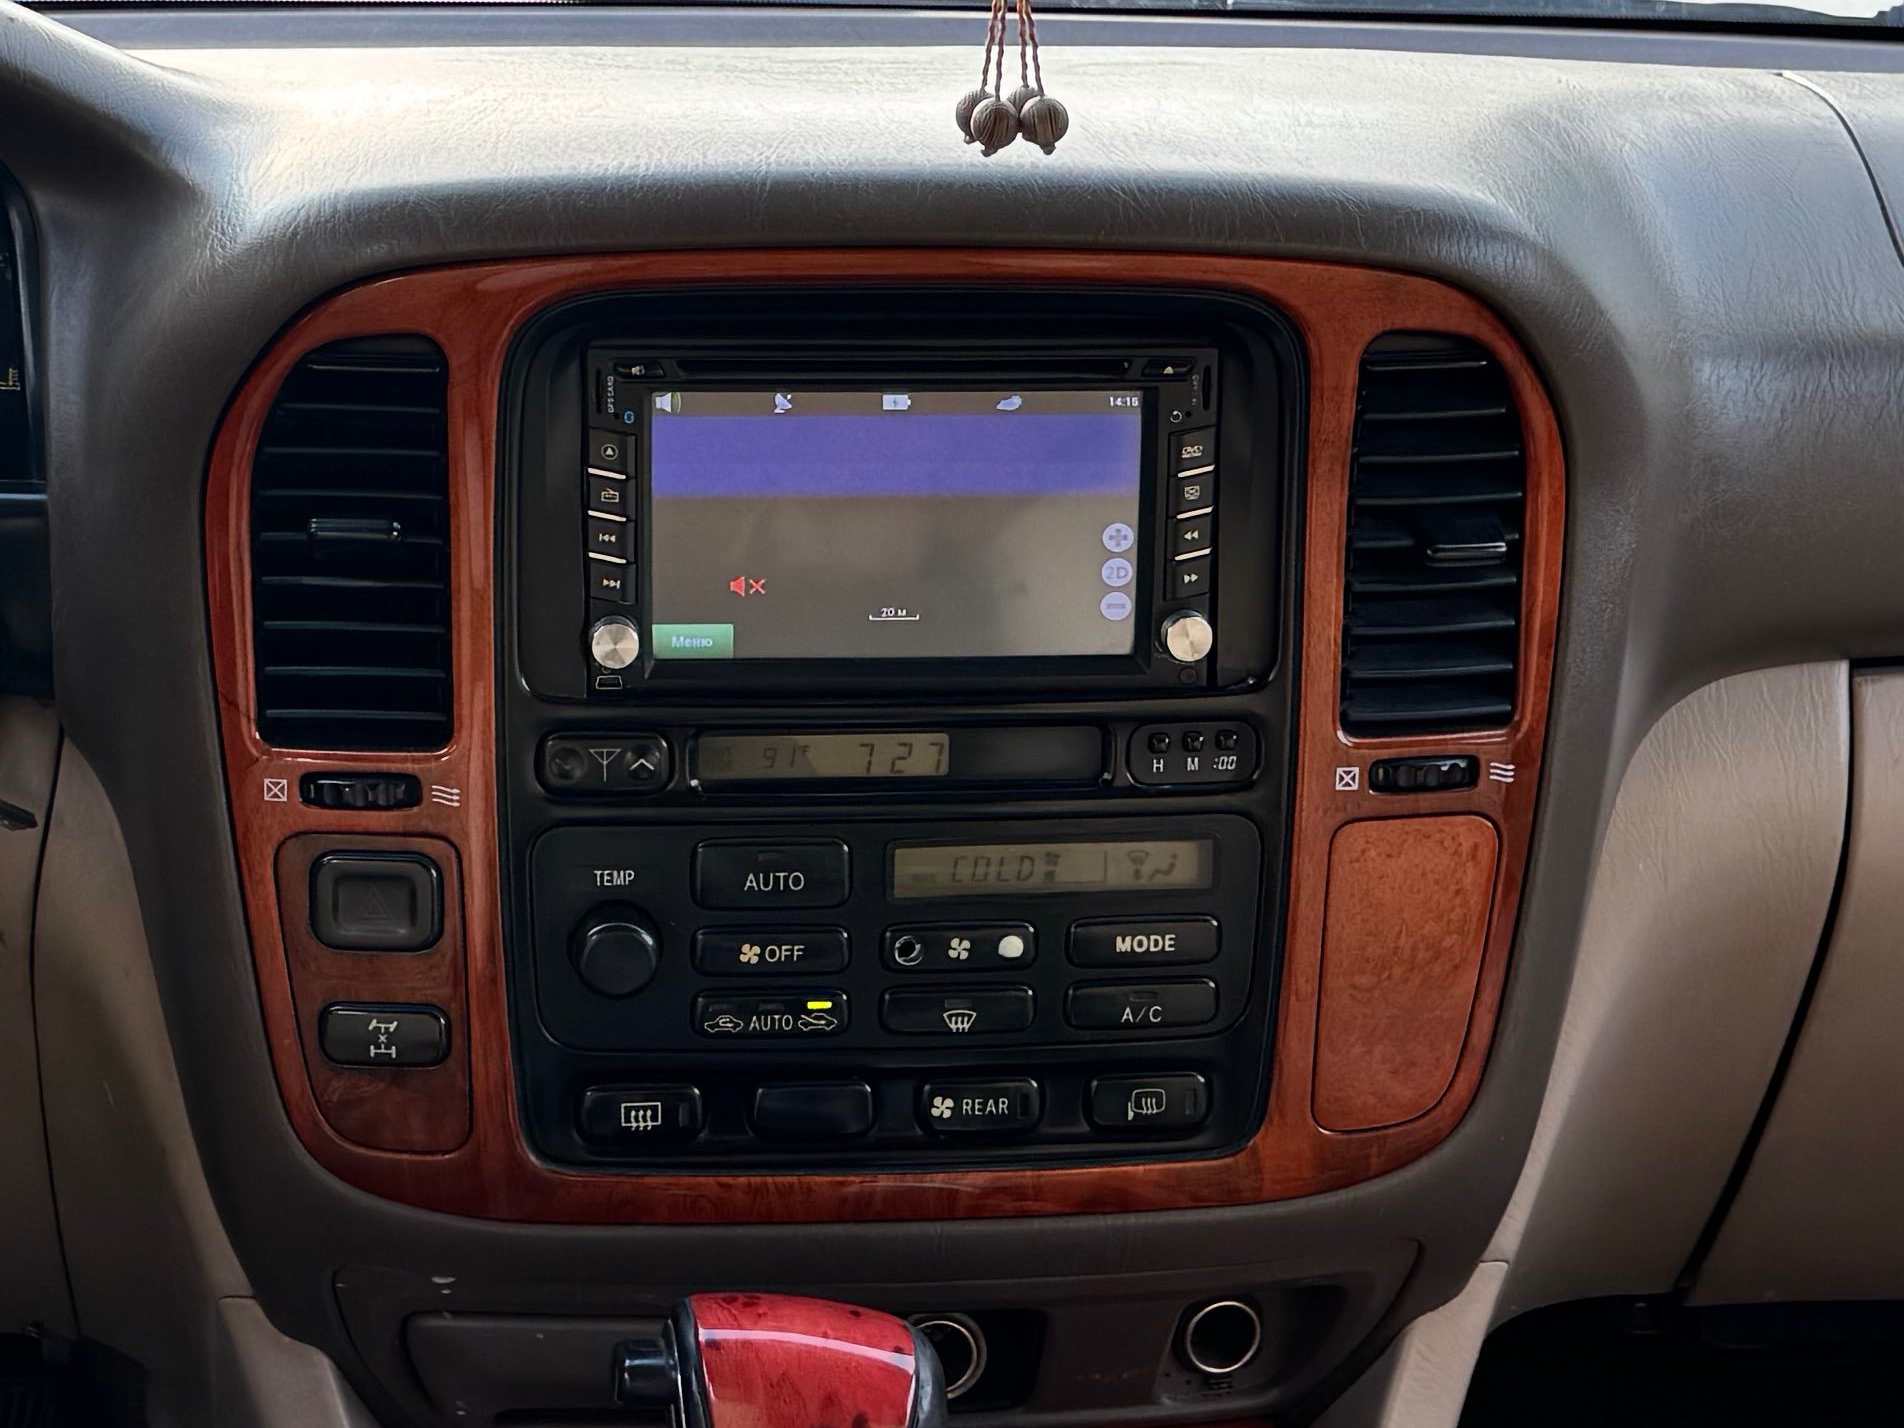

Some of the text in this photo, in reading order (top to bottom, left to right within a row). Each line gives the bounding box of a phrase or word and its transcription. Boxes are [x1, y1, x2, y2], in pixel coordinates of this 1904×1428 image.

[879, 607, 895, 618] 20
[1152, 758, 1164, 772] H
[1186, 756, 1199, 771] M
[594, 869, 636, 888] TEMP
[743, 872, 806, 893] AUTO
[764, 943, 805, 964] OFF
[1114, 933, 1177, 954] MODE
[748, 1012, 794, 1034] AUTO
[1121, 1003, 1163, 1025] A/C
[962, 1095, 1010, 1118] REAR
